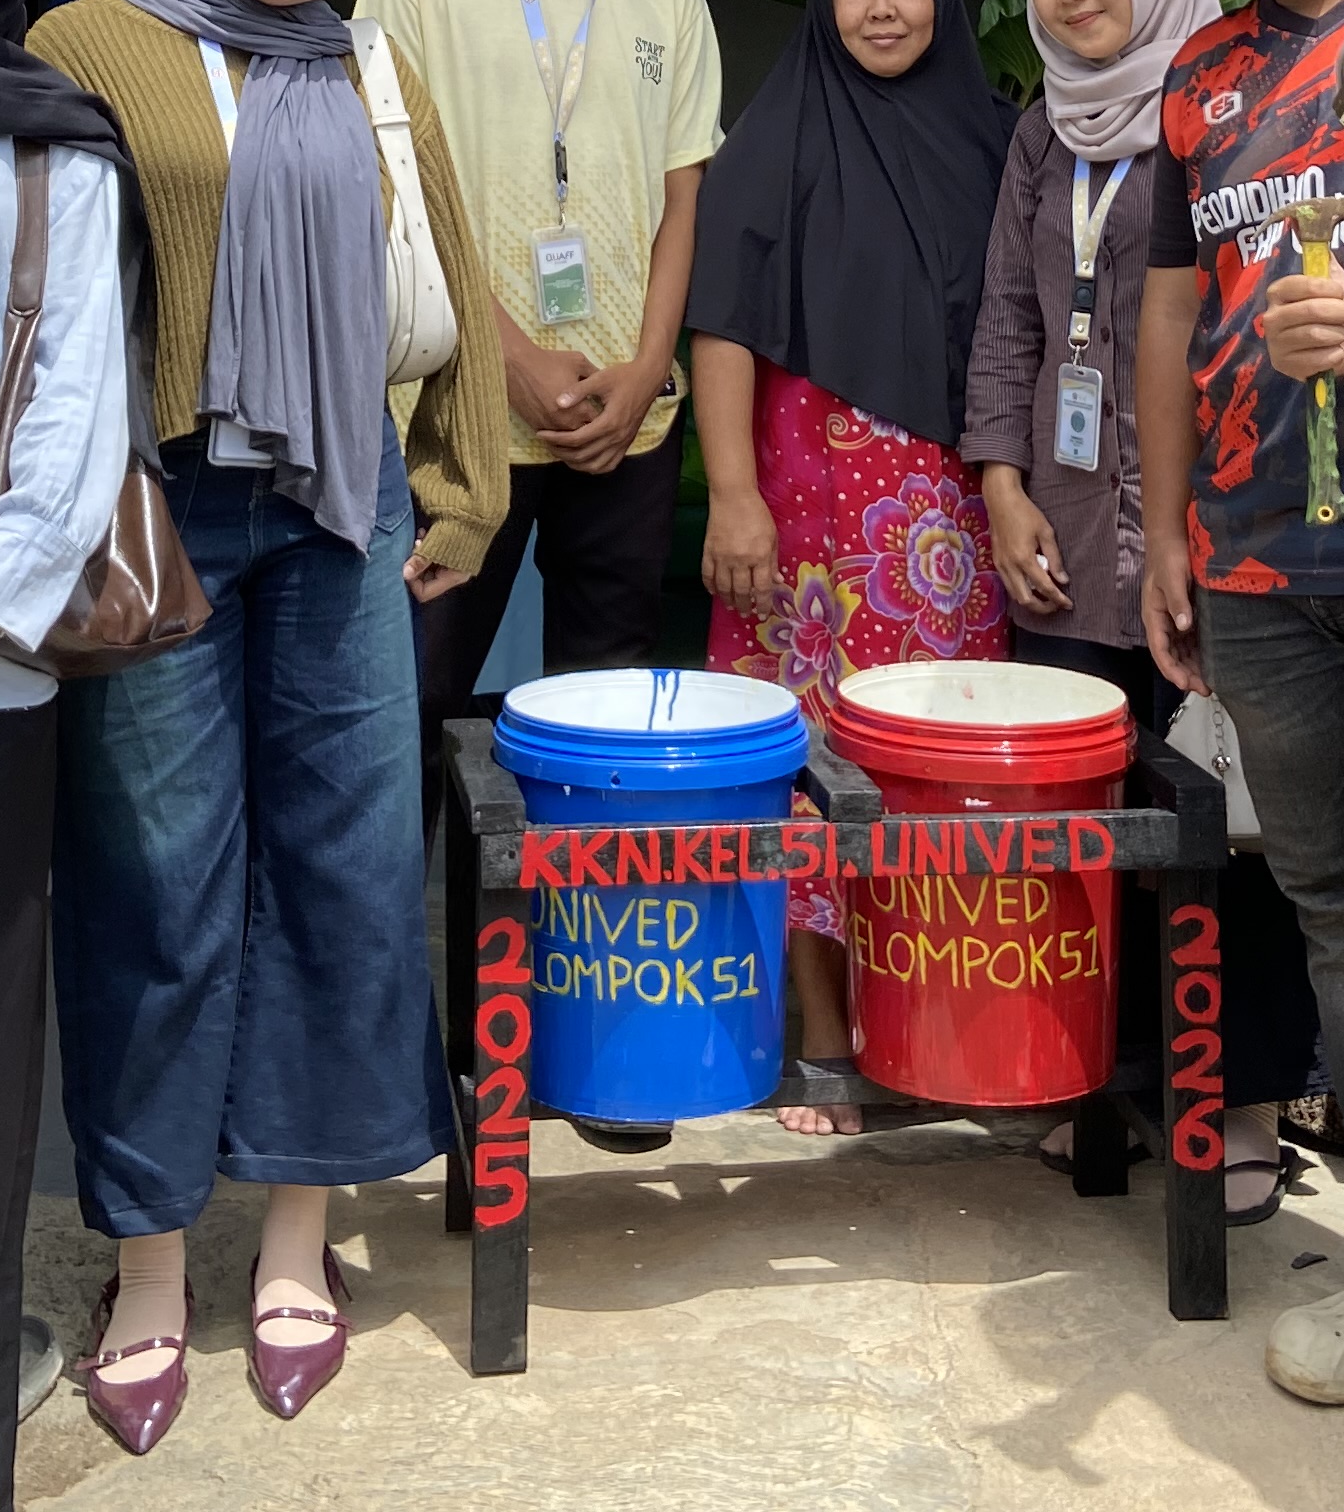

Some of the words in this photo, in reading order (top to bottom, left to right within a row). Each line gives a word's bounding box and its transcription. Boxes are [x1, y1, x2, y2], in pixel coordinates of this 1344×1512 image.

[869, 875, 1050, 927] UNIVED
[871, 817, 1116, 877] UNIVED
[474, 916, 532, 1228] 2025
[1169, 903, 1224, 1172] 2026
